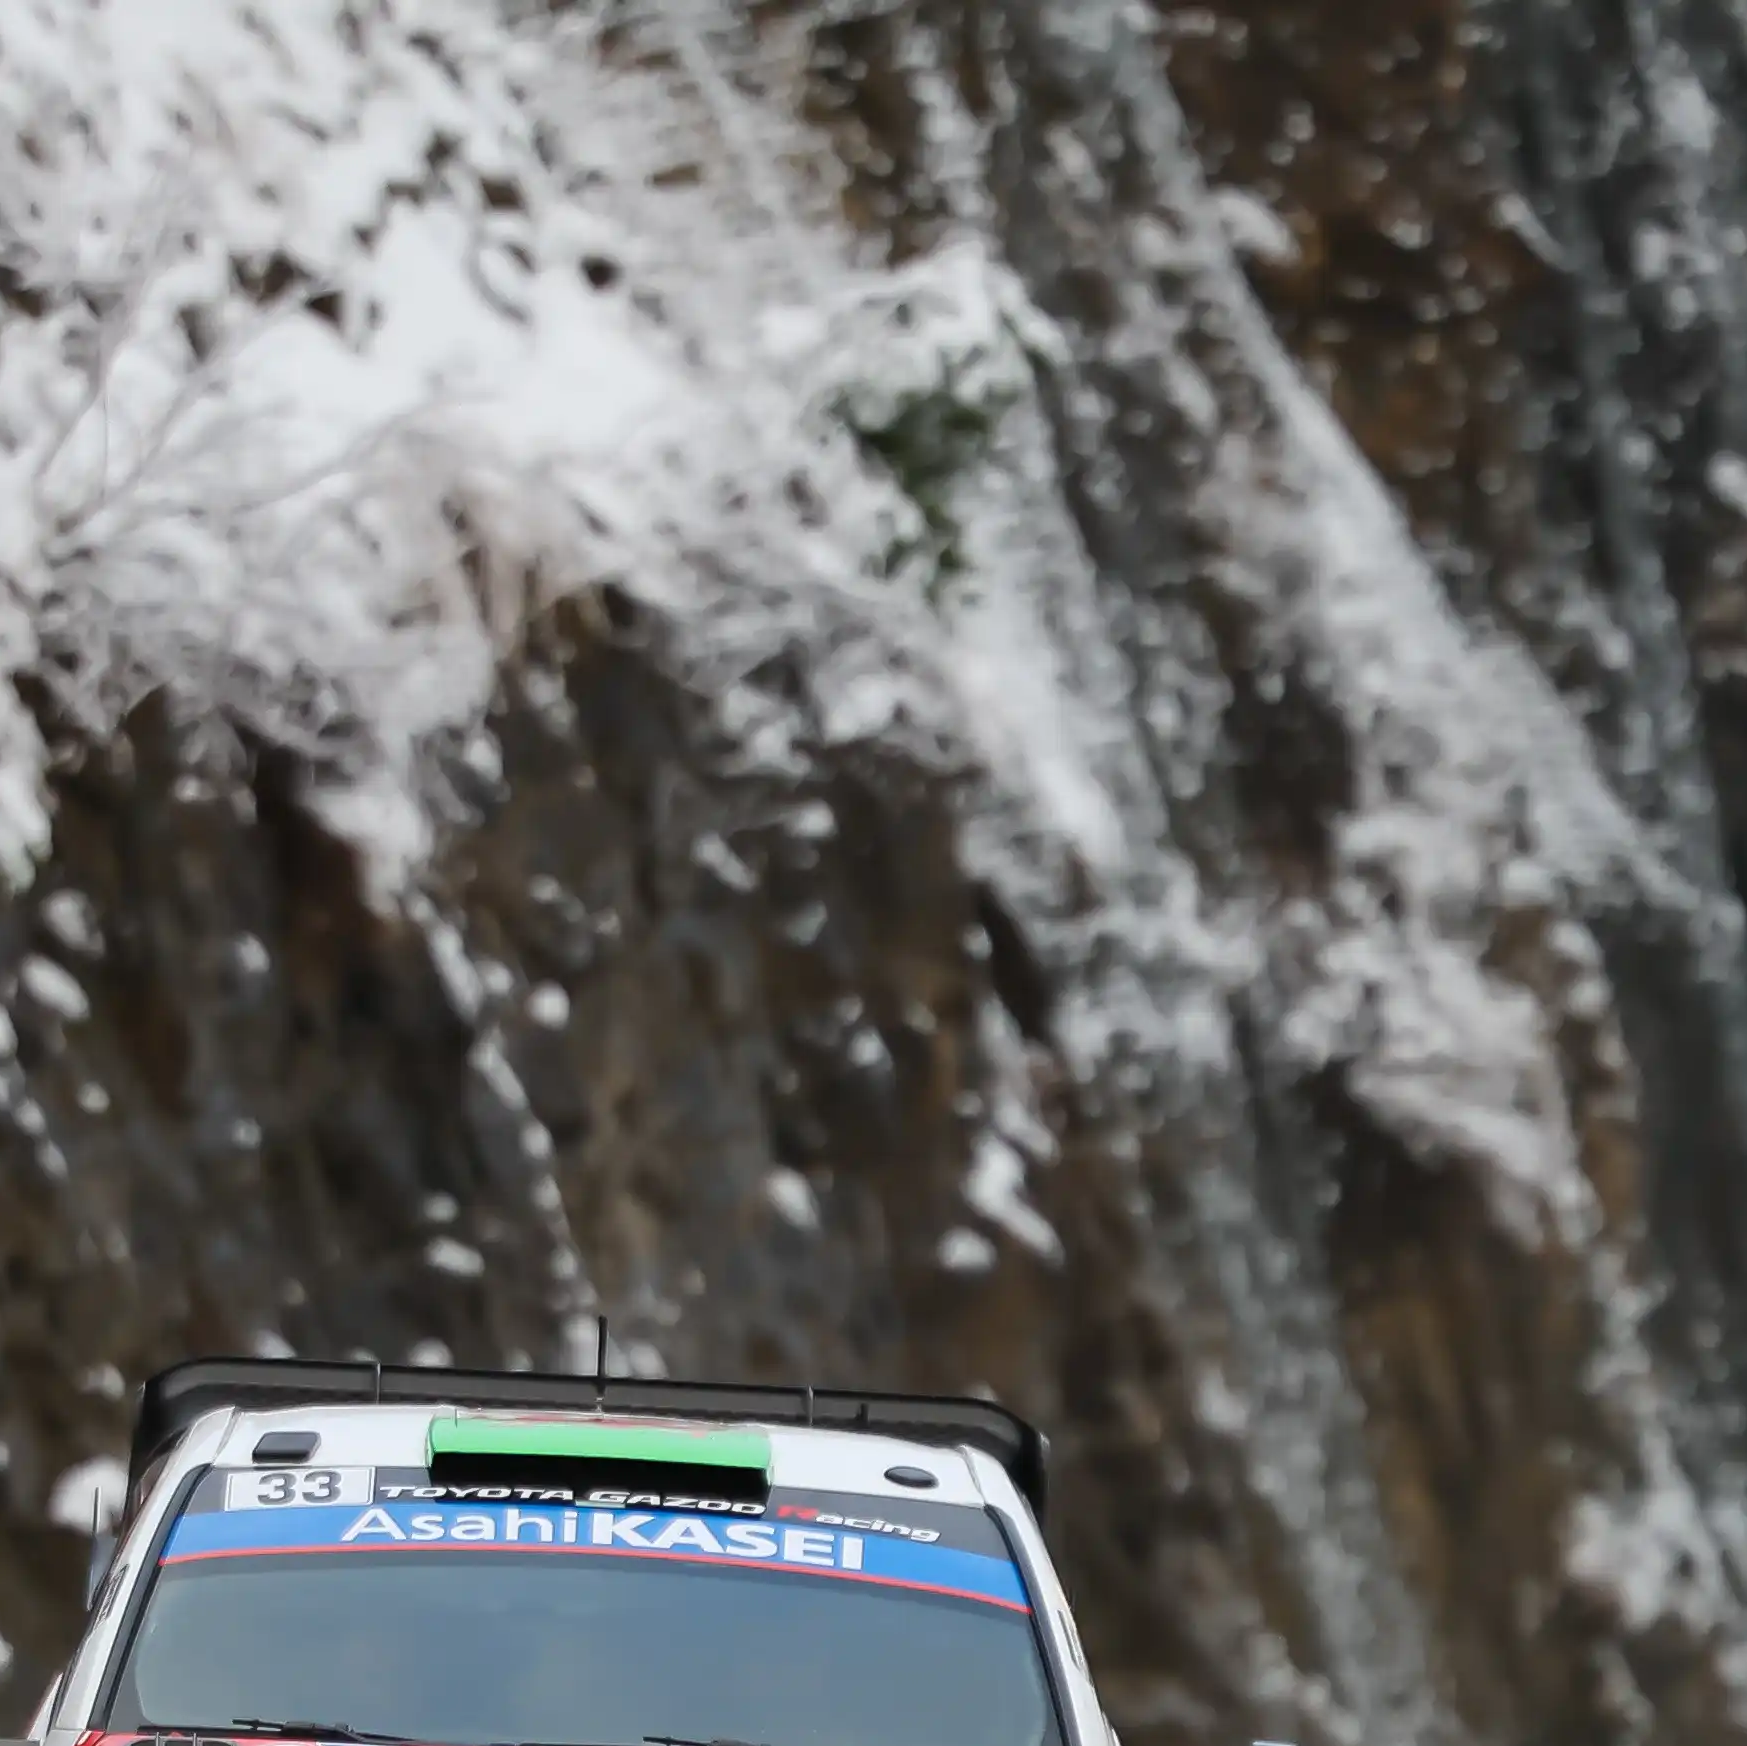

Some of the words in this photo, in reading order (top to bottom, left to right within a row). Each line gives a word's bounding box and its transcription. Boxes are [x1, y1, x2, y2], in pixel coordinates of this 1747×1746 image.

[257, 1469, 343, 1507] 33
[379, 1485, 575, 1502] TOYOTA
[588, 1489, 768, 1516] GAZOO
[776, 1504, 942, 1543] Racing
